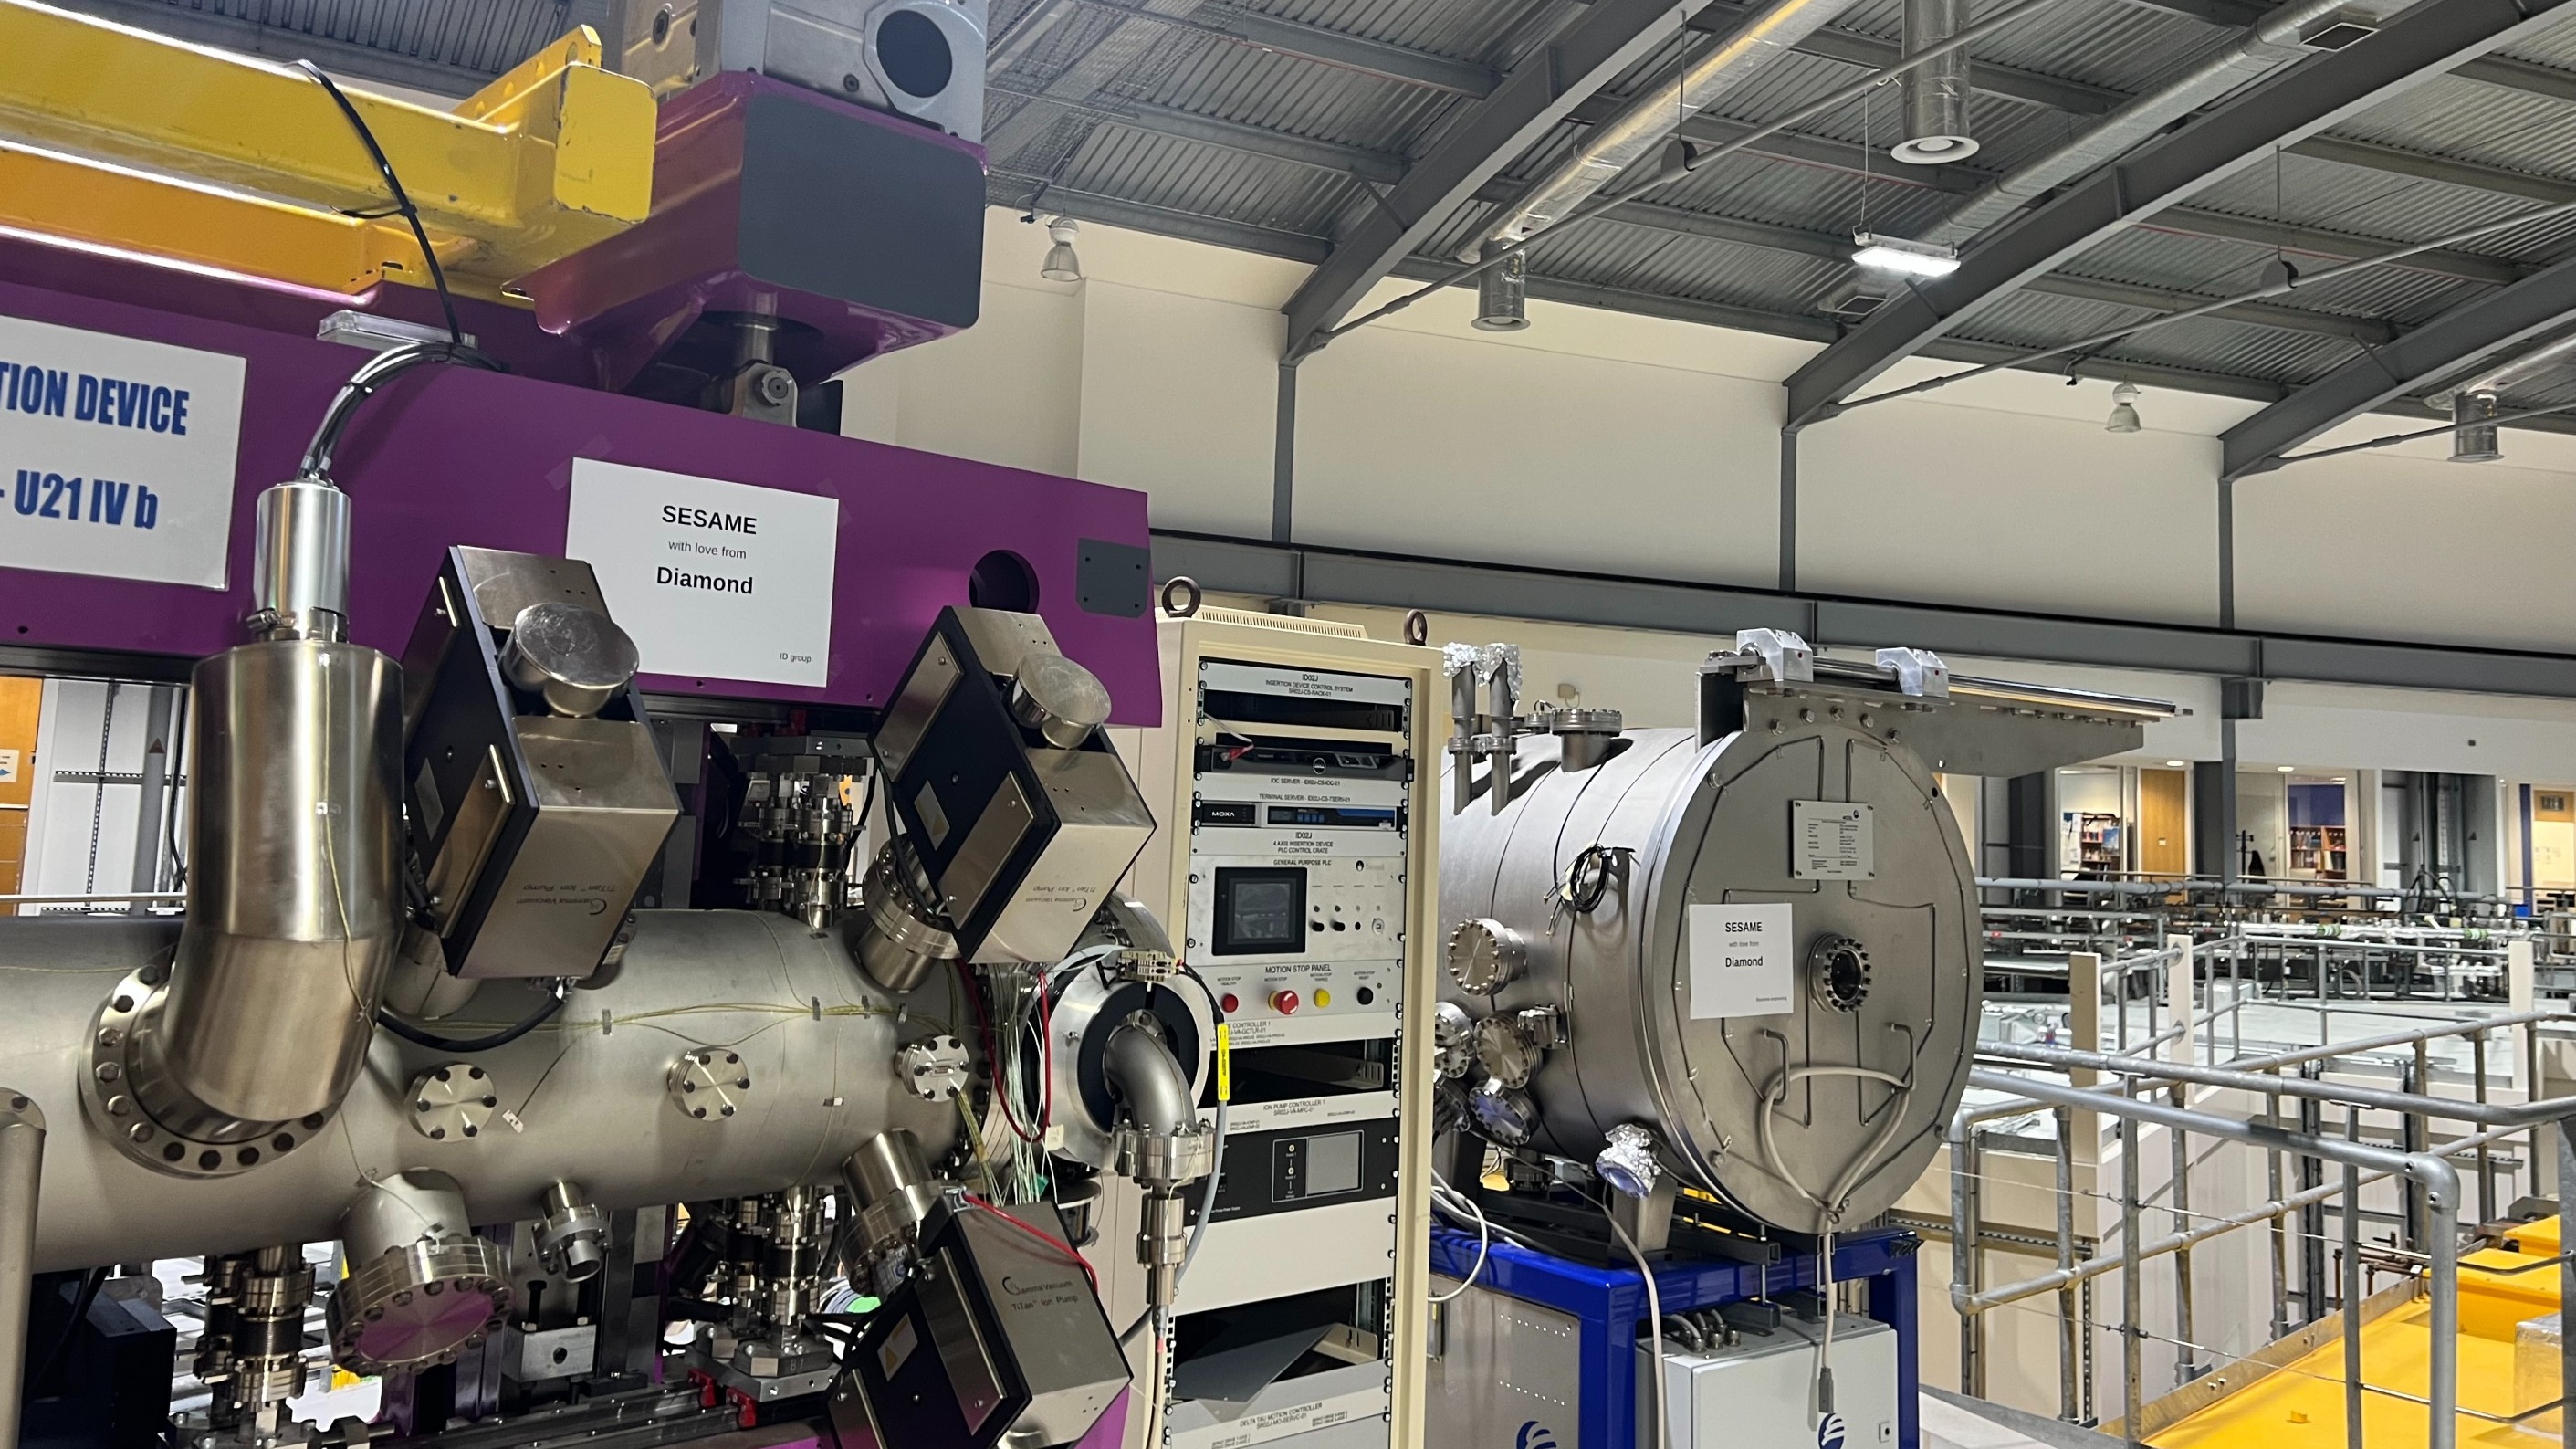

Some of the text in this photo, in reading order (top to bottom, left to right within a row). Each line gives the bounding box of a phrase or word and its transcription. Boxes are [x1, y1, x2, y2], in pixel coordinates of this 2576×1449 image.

[75, 374, 189, 436] DEVICE
[14, 469, 82, 520] U21
[89, 479, 130, 526] IV
[134, 485, 158, 530] b
[662, 505, 757, 535] SESAME
[668, 541, 747, 559] with love from
[656, 566, 753, 594] Diamond
[780, 652, 812, 664] ID group
[1302, 674, 1319, 682] ID02J
[523, 883, 556, 892] Pump
[1725, 921, 1763, 932] SESAME
[1725, 955, 1763, 967] Diamond
[1265, 965, 1292, 973] MOTION
[1293, 964, 1311, 972] STOP
[1232, 1021, 1267, 1029] CONTROLLER
[1288, 1100, 1322, 1108] CONTROLLER
[1002, 1276, 1073, 1296] Gamma Vacuum
[1041, 1298, 1054, 1307] Ion
[1056, 1295, 1079, 1305] Pump
[1240, 1402, 1323, 1427] DELTA TAU MOTION CONTROLLER
